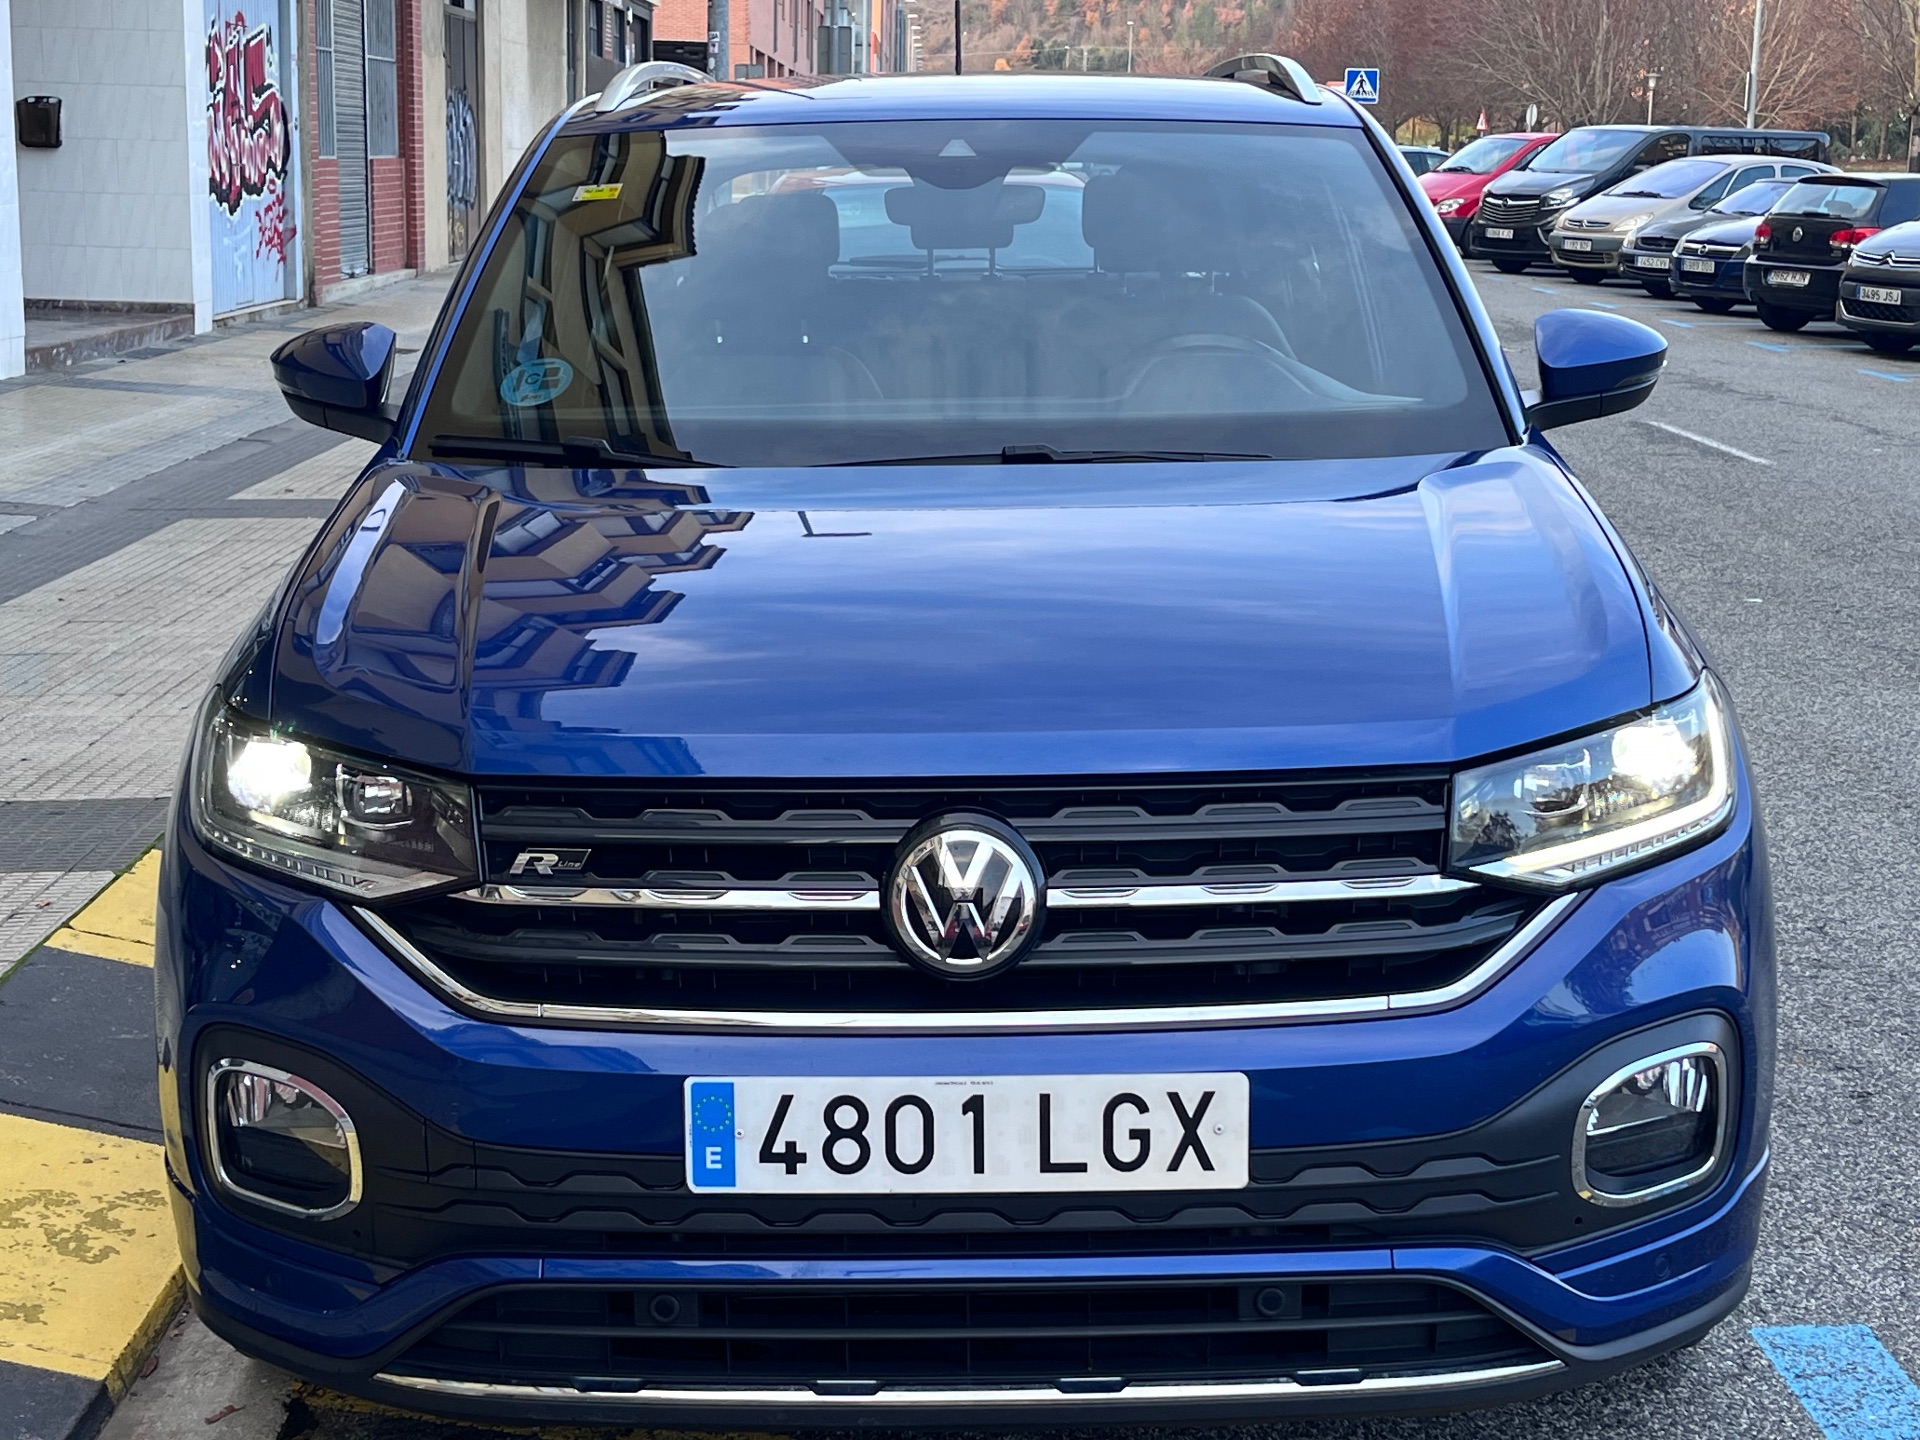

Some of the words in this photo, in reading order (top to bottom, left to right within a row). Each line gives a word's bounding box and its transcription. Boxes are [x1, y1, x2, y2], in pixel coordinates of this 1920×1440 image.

[1861, 288, 1880, 300] 3495
[1883, 291, 1899, 303] JSJ
[509, 852, 559, 875] R
[705, 1146, 722, 1169] E
[759, 1094, 985, 1175] 4801
[1039, 1091, 1216, 1173] LGX
